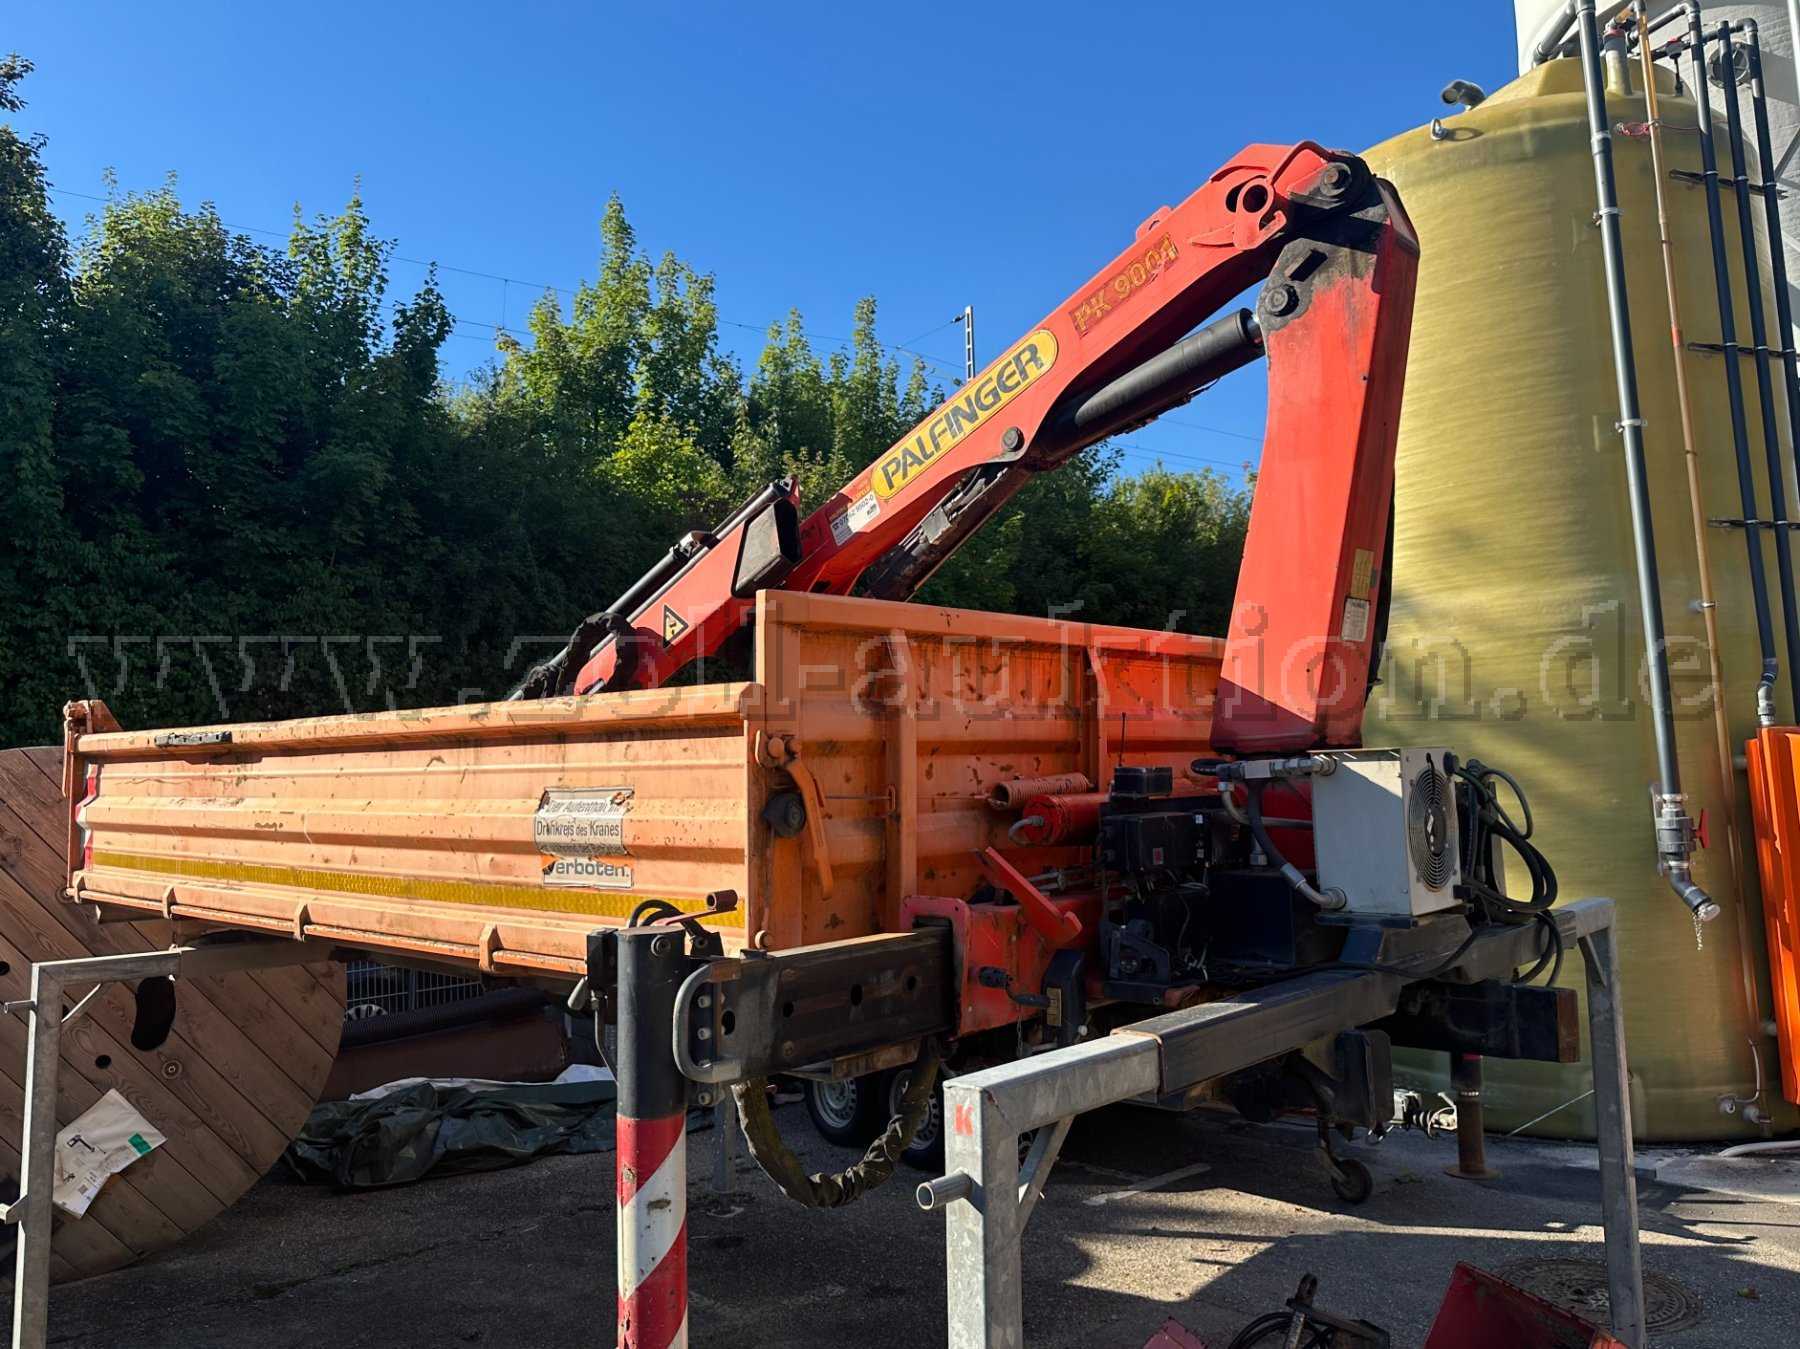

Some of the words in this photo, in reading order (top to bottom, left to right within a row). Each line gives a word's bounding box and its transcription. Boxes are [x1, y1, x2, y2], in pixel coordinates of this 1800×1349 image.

[880, 343, 1045, 491] PALFINGER
[576, 825, 588, 837] des
[589, 820, 620, 837] Kranes
[553, 859, 629, 877] erboten.
